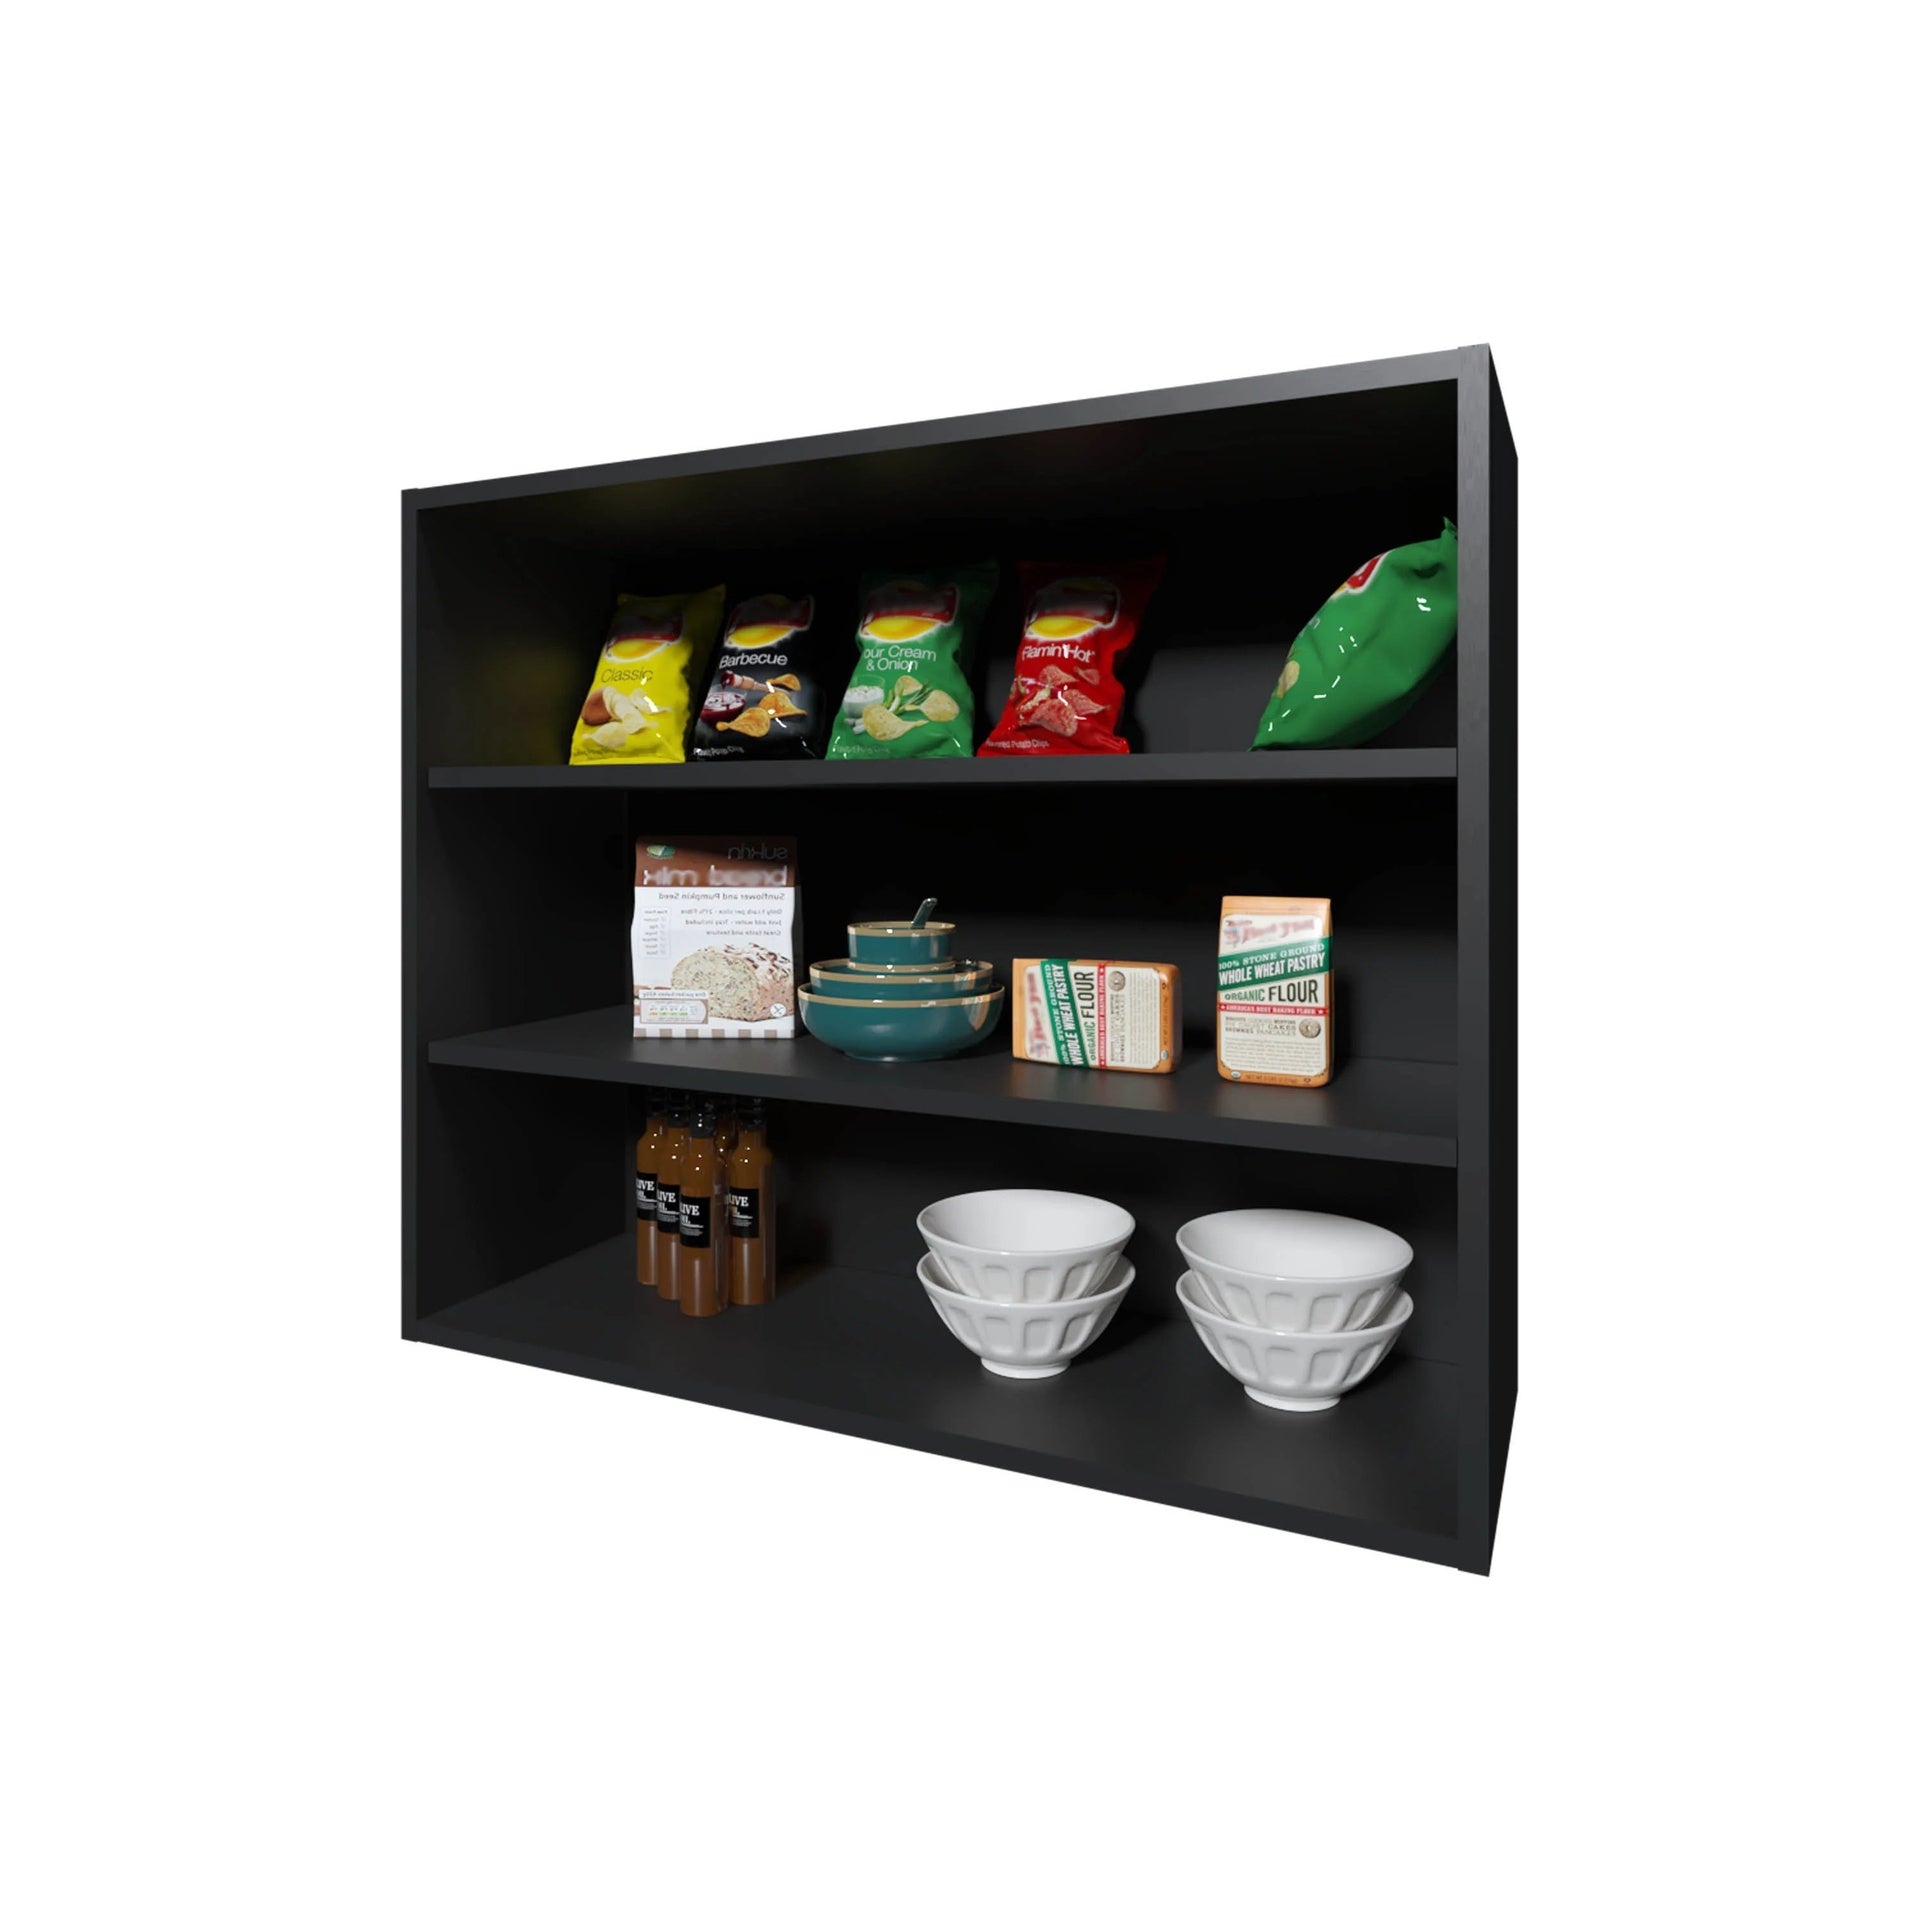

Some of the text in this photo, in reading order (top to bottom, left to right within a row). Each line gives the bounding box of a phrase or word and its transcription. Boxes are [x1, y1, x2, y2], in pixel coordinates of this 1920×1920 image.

[719, 653, 788, 669] Barbecue
[864, 644, 936, 662] our Cream
[866, 657, 918, 672] & Onion
[601, 667, 654, 683] Classic
[1218, 943, 1325, 970] 100% STONE GROUND
[1219, 952, 1326, 986] WHOLE WHEAT PASTRY
[1224, 979, 1318, 1003] ORGANIC FLOUR
[1052, 964, 1084, 1065] WHOLE WHEAT PASTRY
[1074, 972, 1096, 1060] ORGANIC FLOUR
[1052, 1008, 1064, 1041] STONE
[636, 1178, 654, 1191] LIVE
[657, 1189, 676, 1203] LIVE
[728, 1193, 749, 1207] LIVE
[680, 1202, 699, 1216] LIVE
